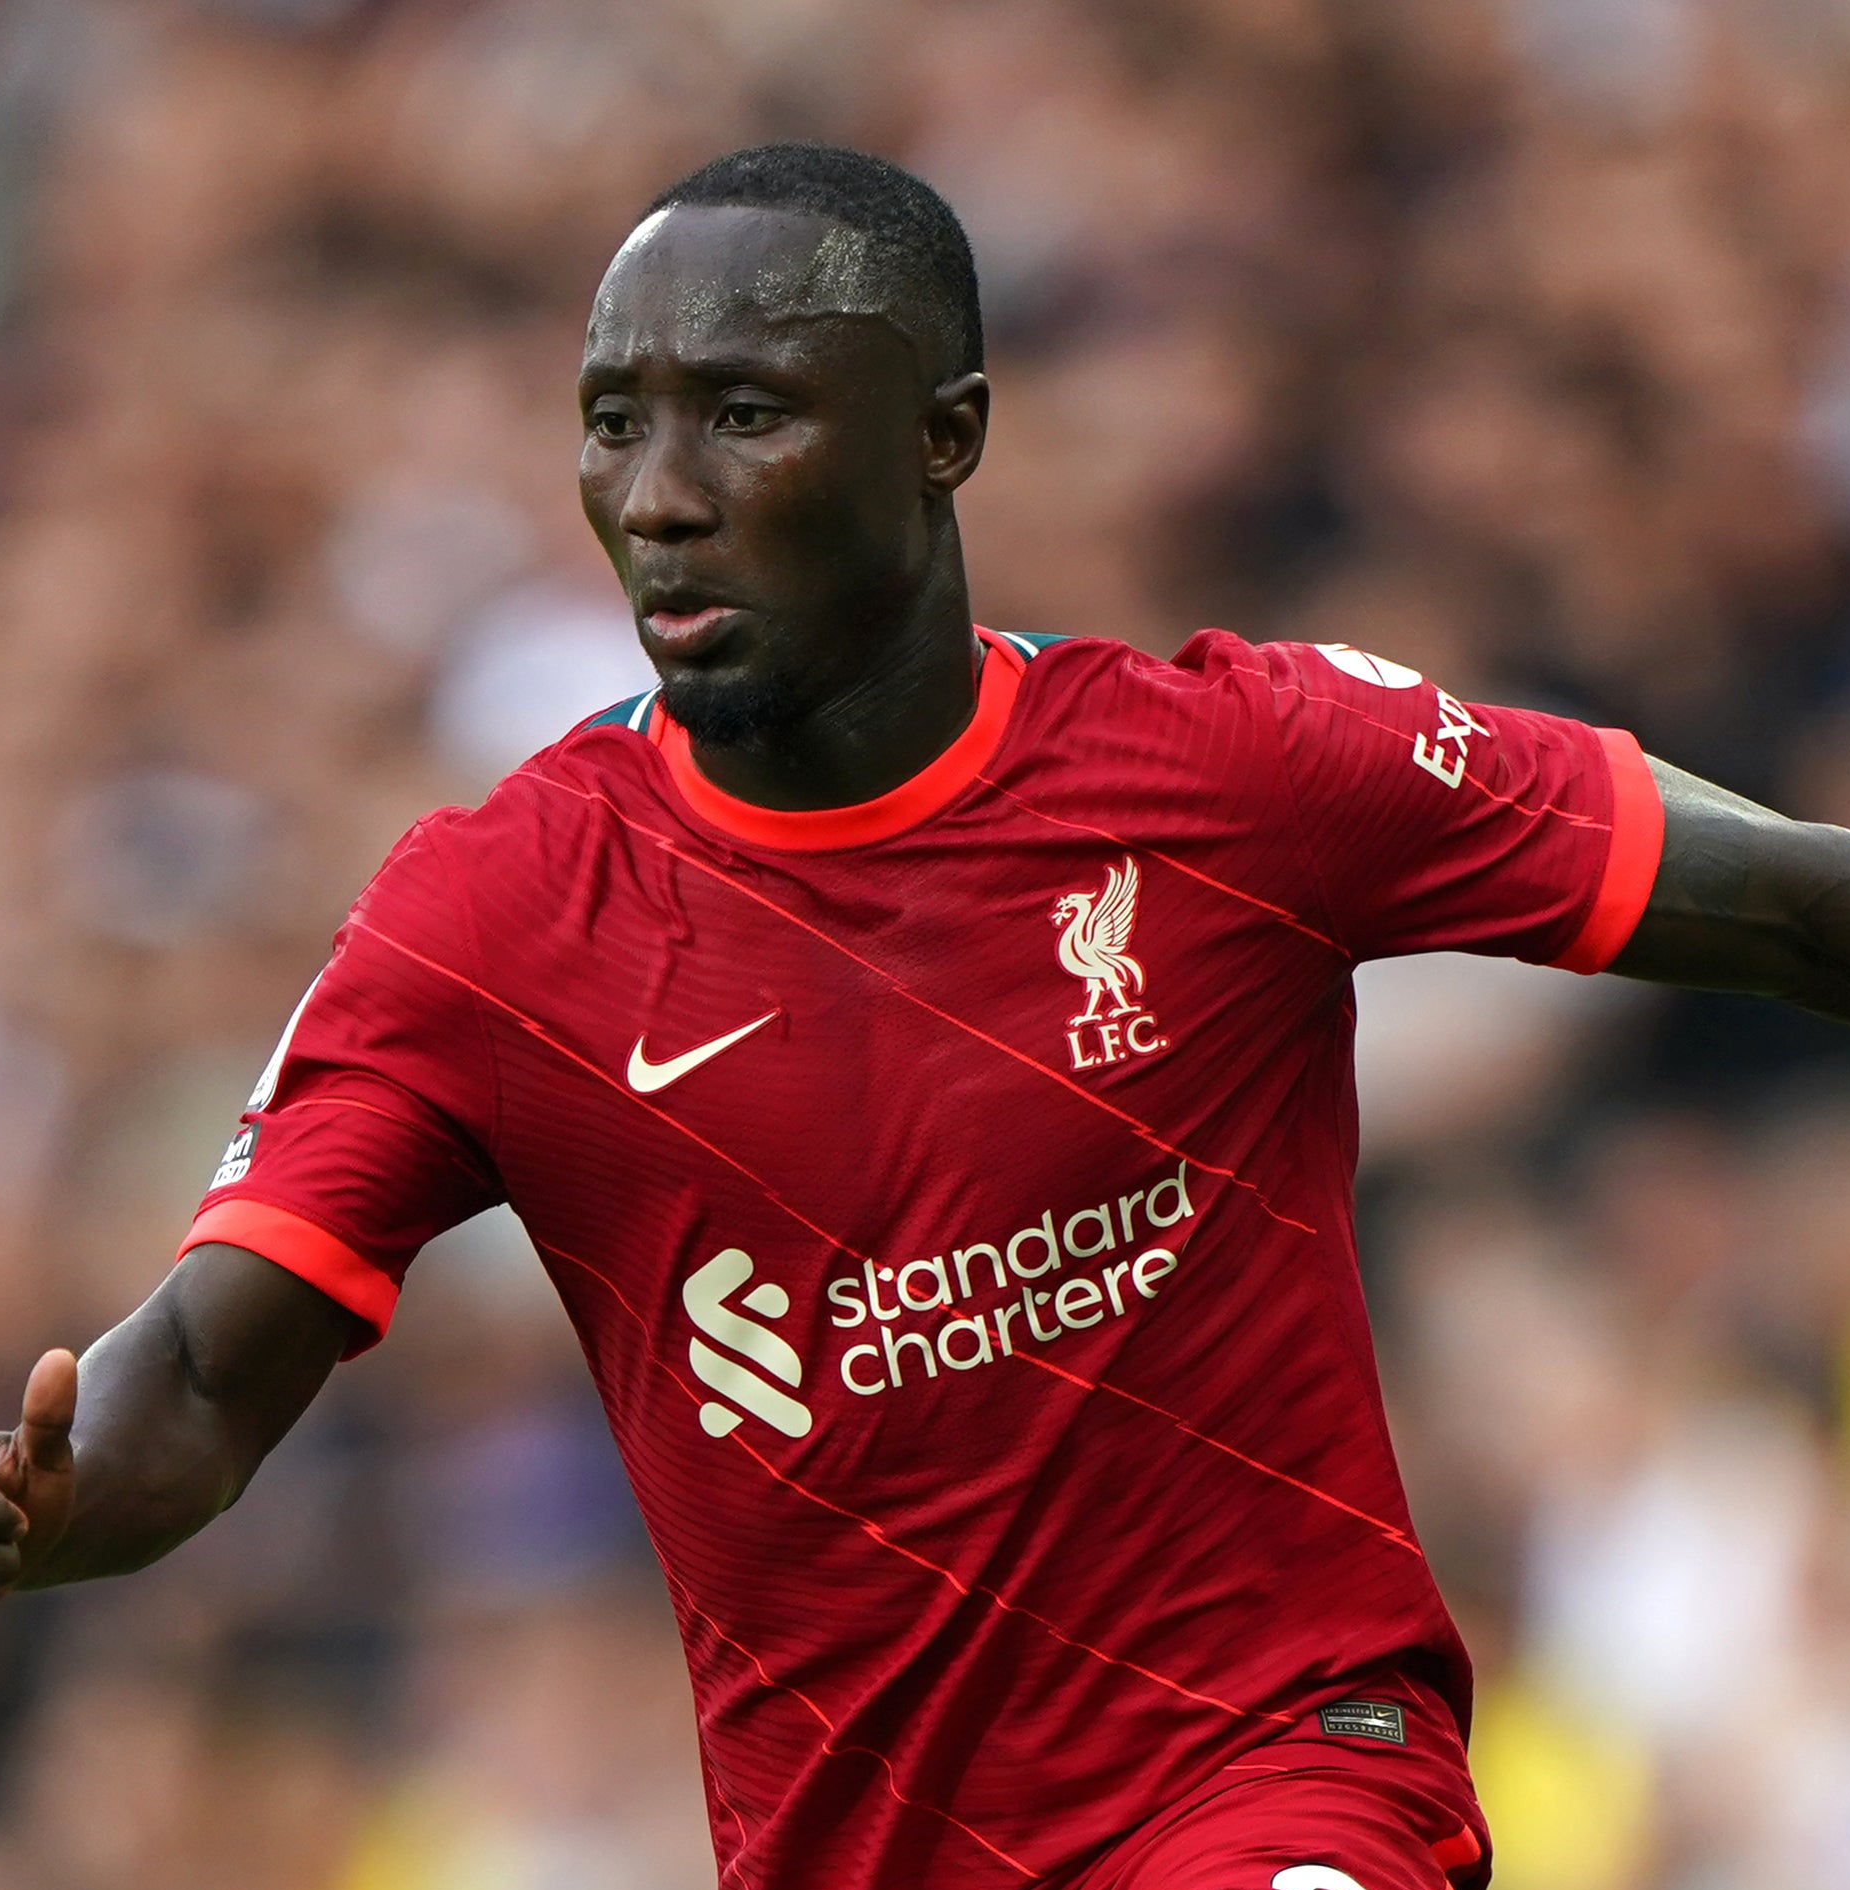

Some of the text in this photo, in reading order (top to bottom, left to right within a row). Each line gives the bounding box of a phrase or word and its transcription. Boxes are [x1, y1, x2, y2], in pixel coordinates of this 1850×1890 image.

[1412, 689, 1492, 790] Exp
[1067, 1015, 1168, 1070] L.F.C.
[826, 1158, 1195, 1329] standard
[839, 1247, 1181, 1396] chartere
